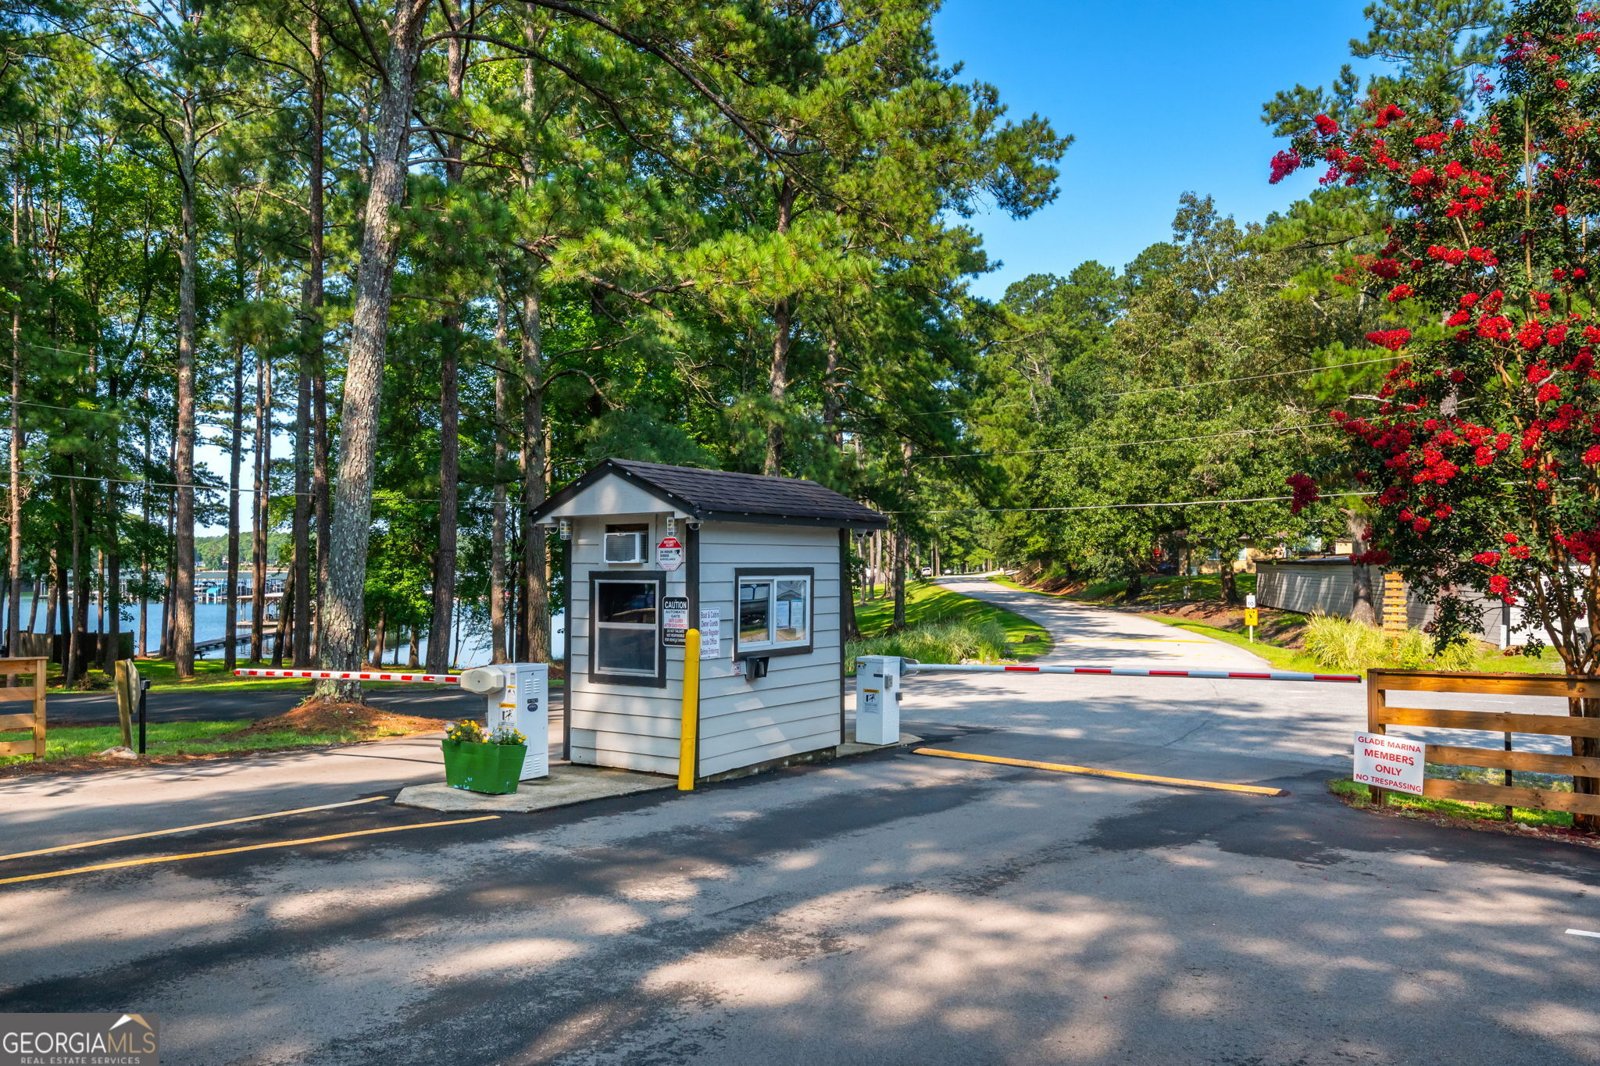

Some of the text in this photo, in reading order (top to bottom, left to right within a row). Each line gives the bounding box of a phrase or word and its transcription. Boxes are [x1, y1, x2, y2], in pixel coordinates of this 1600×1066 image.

[1358, 736, 1421, 753] GLADE MARINA
[1364, 749, 1414, 766] MEMBERS
[1375, 764, 1402, 776] ONLY
[1370, 776, 1421, 792] TRESPASSING
